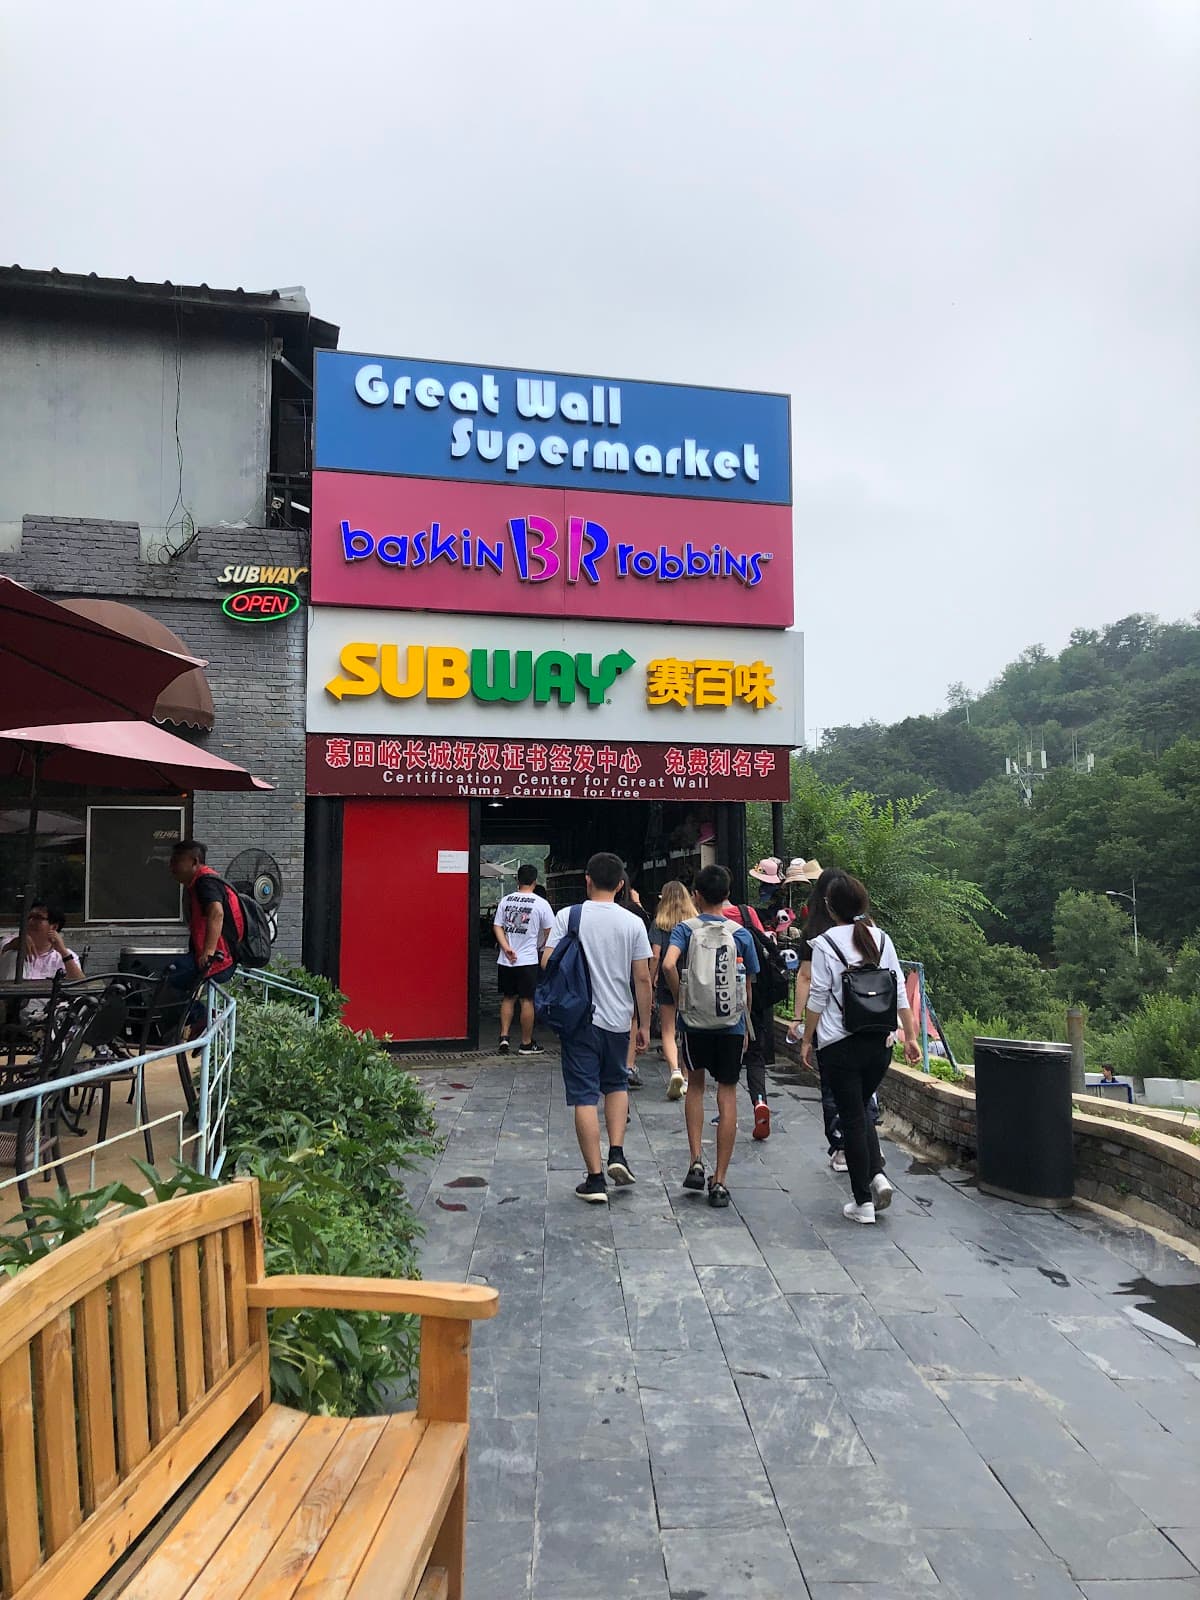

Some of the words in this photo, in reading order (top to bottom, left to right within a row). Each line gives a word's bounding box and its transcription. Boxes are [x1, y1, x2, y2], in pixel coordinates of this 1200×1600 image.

[354, 364, 500, 415] Great
[515, 377, 623, 425] Wall
[450, 417, 760, 482] Supermarket
[216, 565, 309, 585] SUBWAY
[231, 594, 289, 613] OPEN
[324, 642, 636, 705] SUBWAY
[646, 657, 777, 709] 赛百味
[325, 738, 642, 774] 慕田峪长城好汉证书签发中心
[664, 747, 776, 777] 免费刻名字
[382, 770, 503, 785] Certification
[518, 773, 577, 787] Center
[585, 774, 610, 787] for
[618, 775, 665, 788] Great
[673, 777, 709, 789] Wall
[458, 784, 500, 796] Name
[512, 785, 572, 799] Carving
[583, 786, 605, 798] for
[611, 787, 640, 799] free
[716, 951, 730, 1013] adidas
